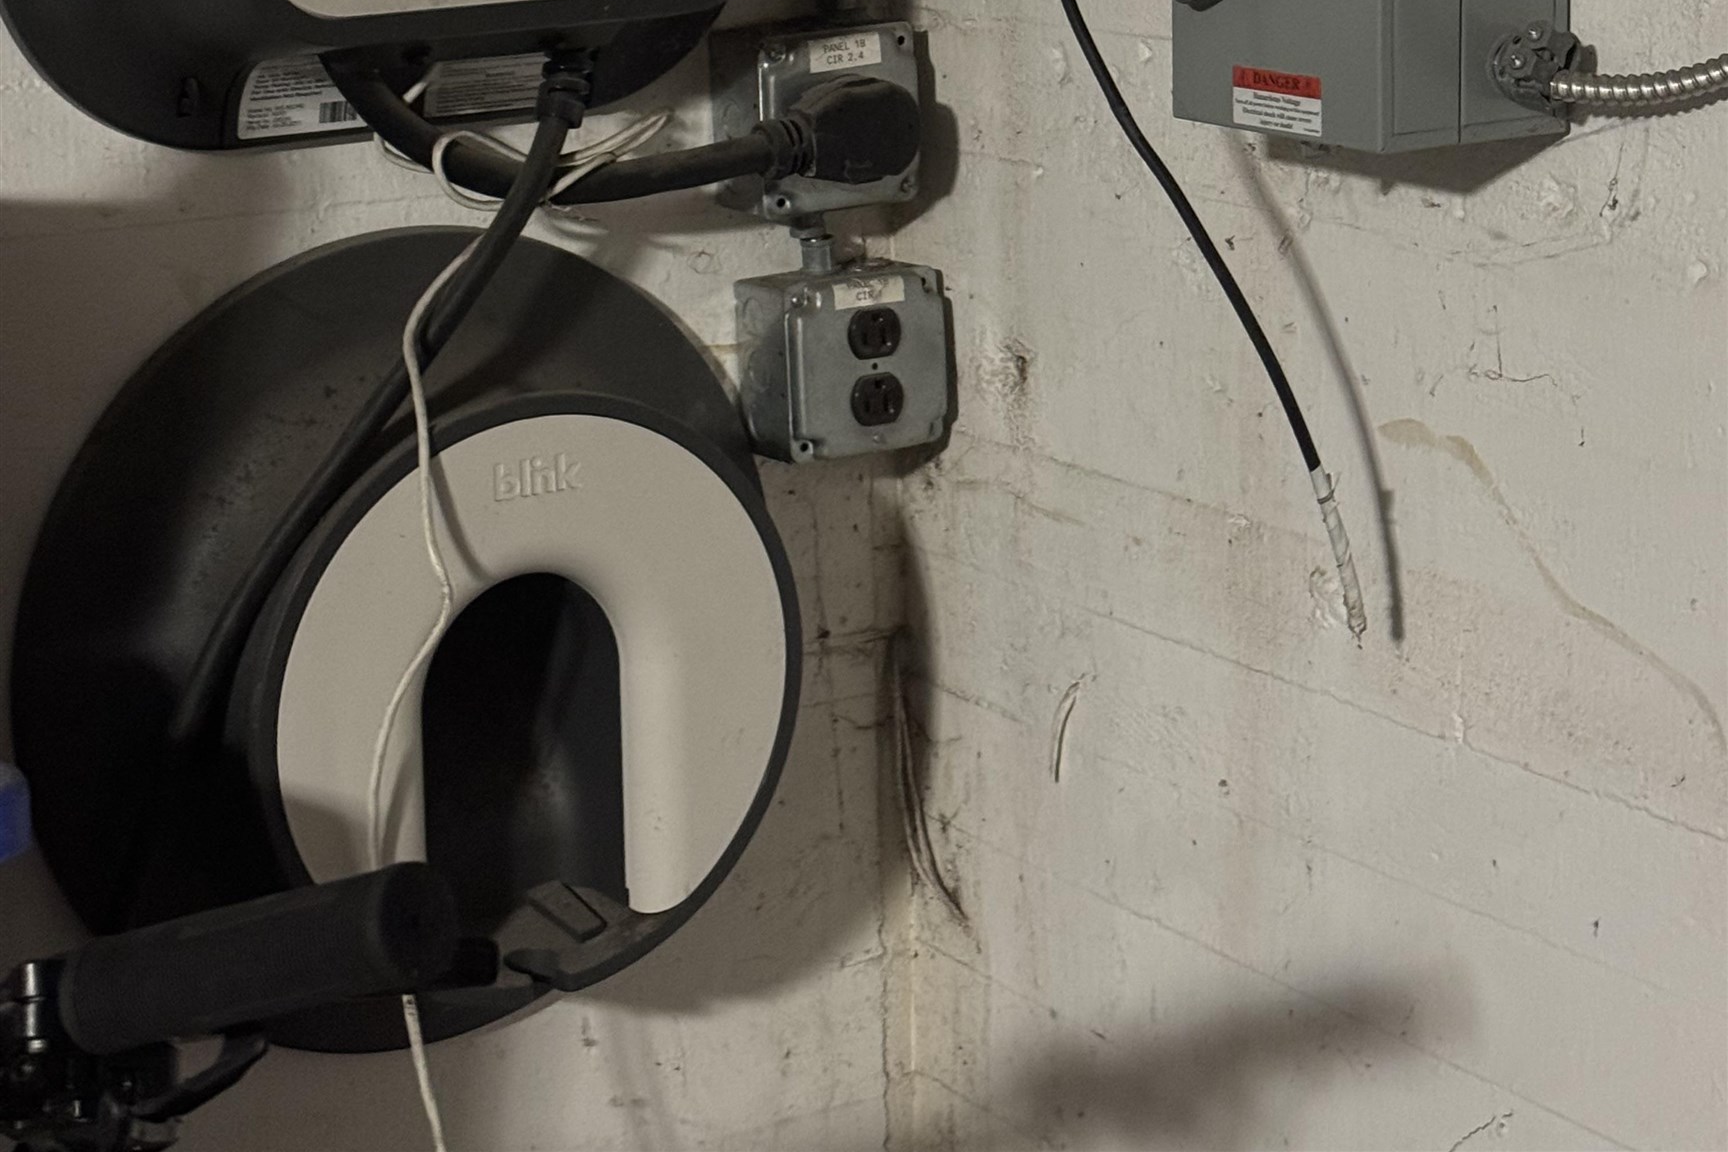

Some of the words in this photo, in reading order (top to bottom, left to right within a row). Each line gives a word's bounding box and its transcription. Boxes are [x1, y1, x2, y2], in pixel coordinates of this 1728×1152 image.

[824, 42, 850, 54] PANEL
[827, 54, 844, 65] CIR
[1253, 71, 1301, 90] DANGER
[493, 453, 582, 502] blink
